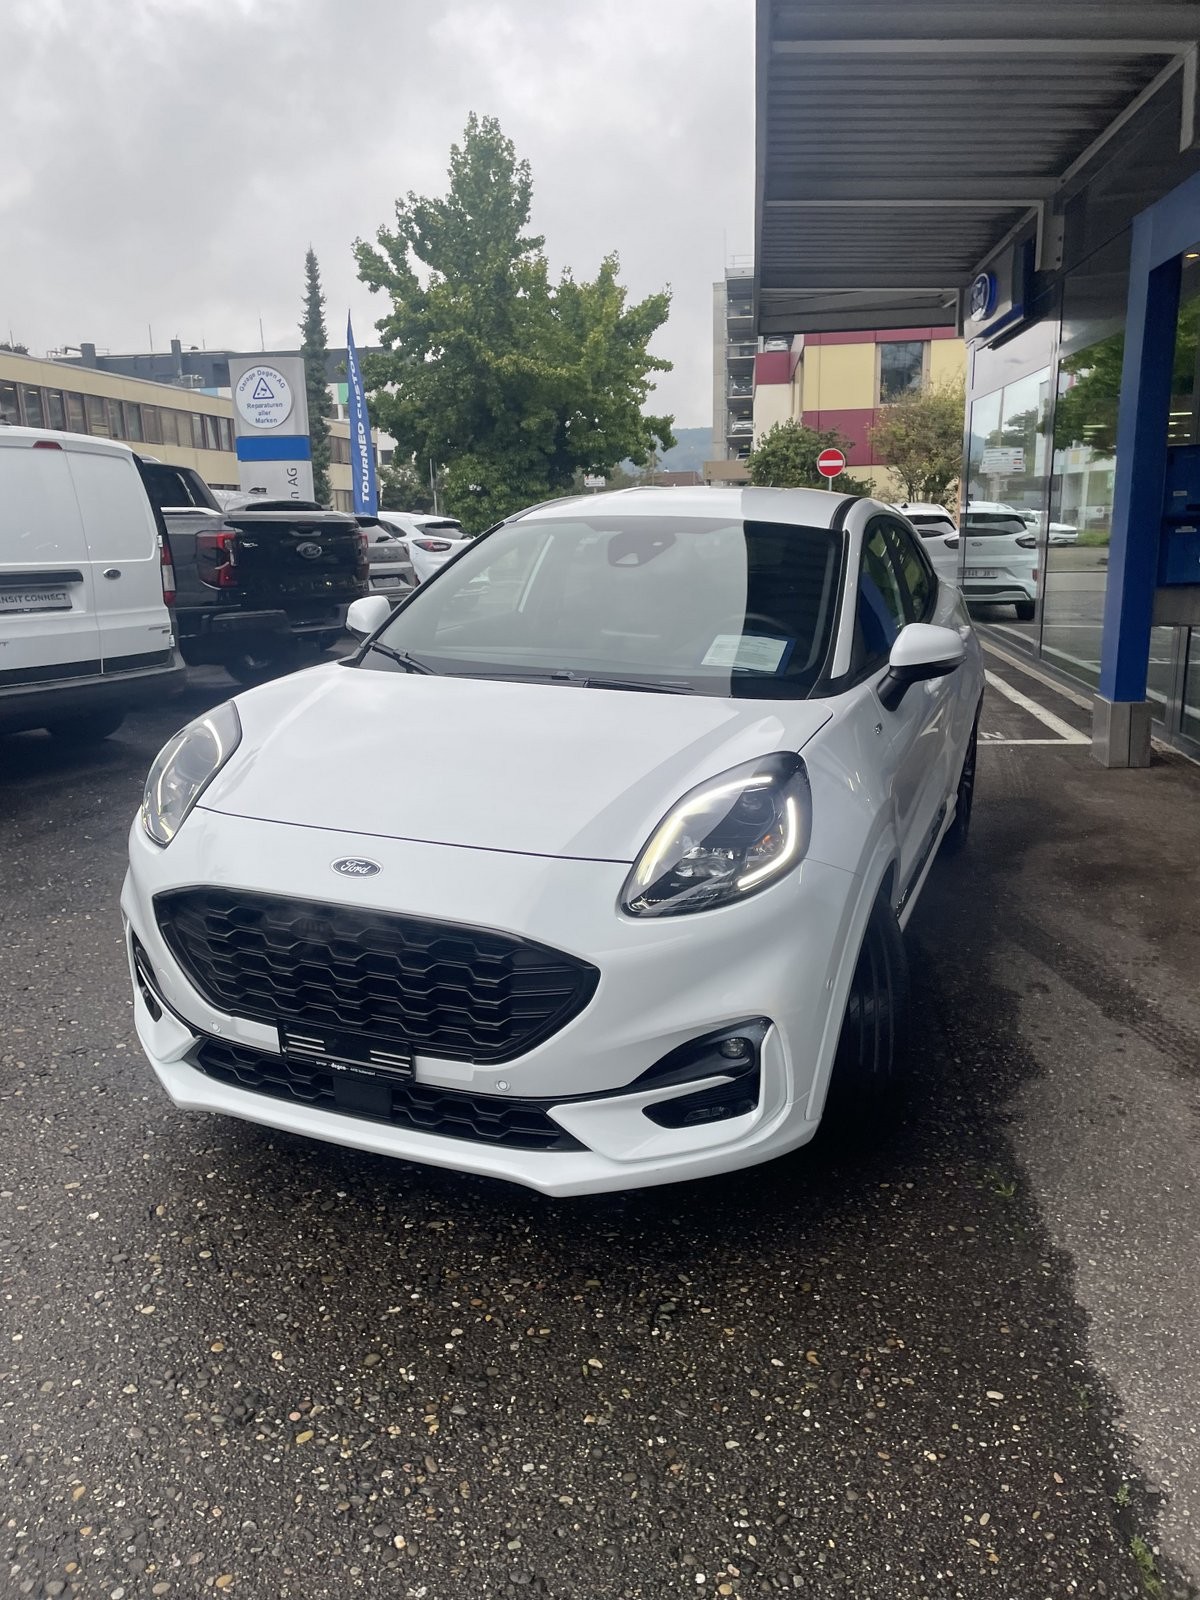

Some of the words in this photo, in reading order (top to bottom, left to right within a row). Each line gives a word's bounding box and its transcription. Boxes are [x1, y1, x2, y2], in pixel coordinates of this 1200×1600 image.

[239, 373, 256, 391] Garage
[256, 369, 278, 380] Degen
[276, 378, 286, 389] AG
[348, 344, 361, 418] CUSTOM
[246, 402, 284, 410] Reparaturen
[255, 417, 278, 425] Marken
[357, 421, 370, 503] TOURNEO
[286, 467, 299, 487] AG
[0, 594, 23, 603] NSIT
[25, 592, 66, 601] CONNECT
[340, 859, 372, 874] Ford
